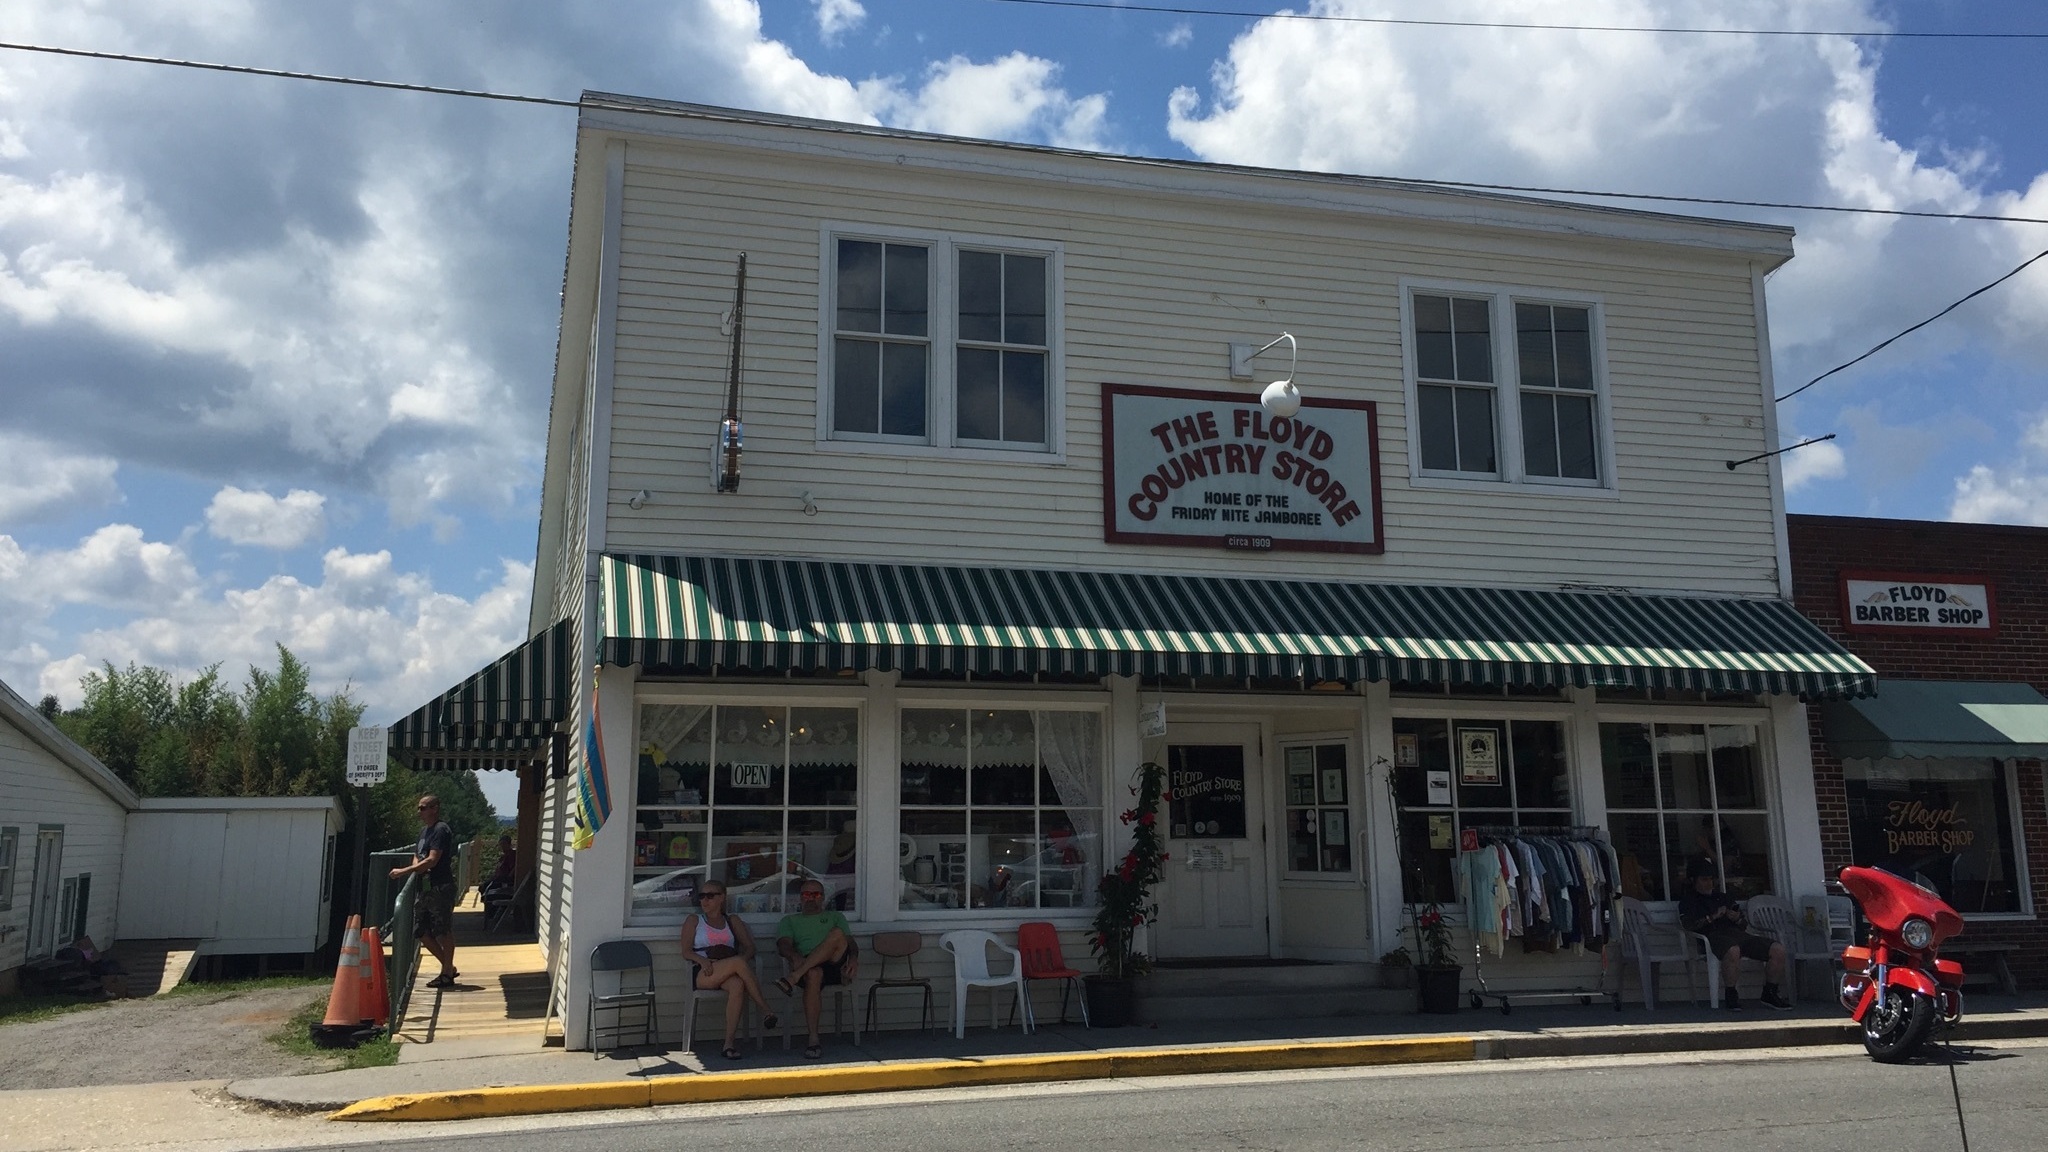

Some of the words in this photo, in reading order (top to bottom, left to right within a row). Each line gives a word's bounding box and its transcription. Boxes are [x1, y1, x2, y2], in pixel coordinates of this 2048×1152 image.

[1150, 410, 1219, 453] THE
[1233, 409, 1334, 461] FLOYD
[1128, 443, 1266, 522] COUNTRY
[1272, 451, 1361, 528] STORE
[1204, 491, 1242, 506] HOME
[1245, 493, 1263, 507] OF
[1265, 495, 1289, 509] THE
[1171, 506, 1216, 521] FRIDAY
[1222, 508, 1250, 522] NITE
[1254, 510, 1322, 526] JAMBOREE
[1228, 536, 1249, 547] circa
[1252, 537, 1271, 548] 1909
[1888, 585, 1947, 604] FLOYD
[1855, 605, 1930, 623] BARBER
[1937, 608, 1984, 624] SHOP
[358, 728, 379, 739] KEEP
[352, 741, 383, 753] STREET
[353, 753, 381, 765] CLEAR
[735, 764, 768, 785] OPEN
[1172, 770, 1204, 787] FLOYD
[1171, 779, 1213, 801] COUNTRY
[1214, 776, 1242, 792] STORE
[1223, 793, 1242, 803] 1909
[1886, 800, 1968, 830] Floyd
[1887, 830, 1940, 854] BARBER
[1941, 830, 1975, 854] SHOP
